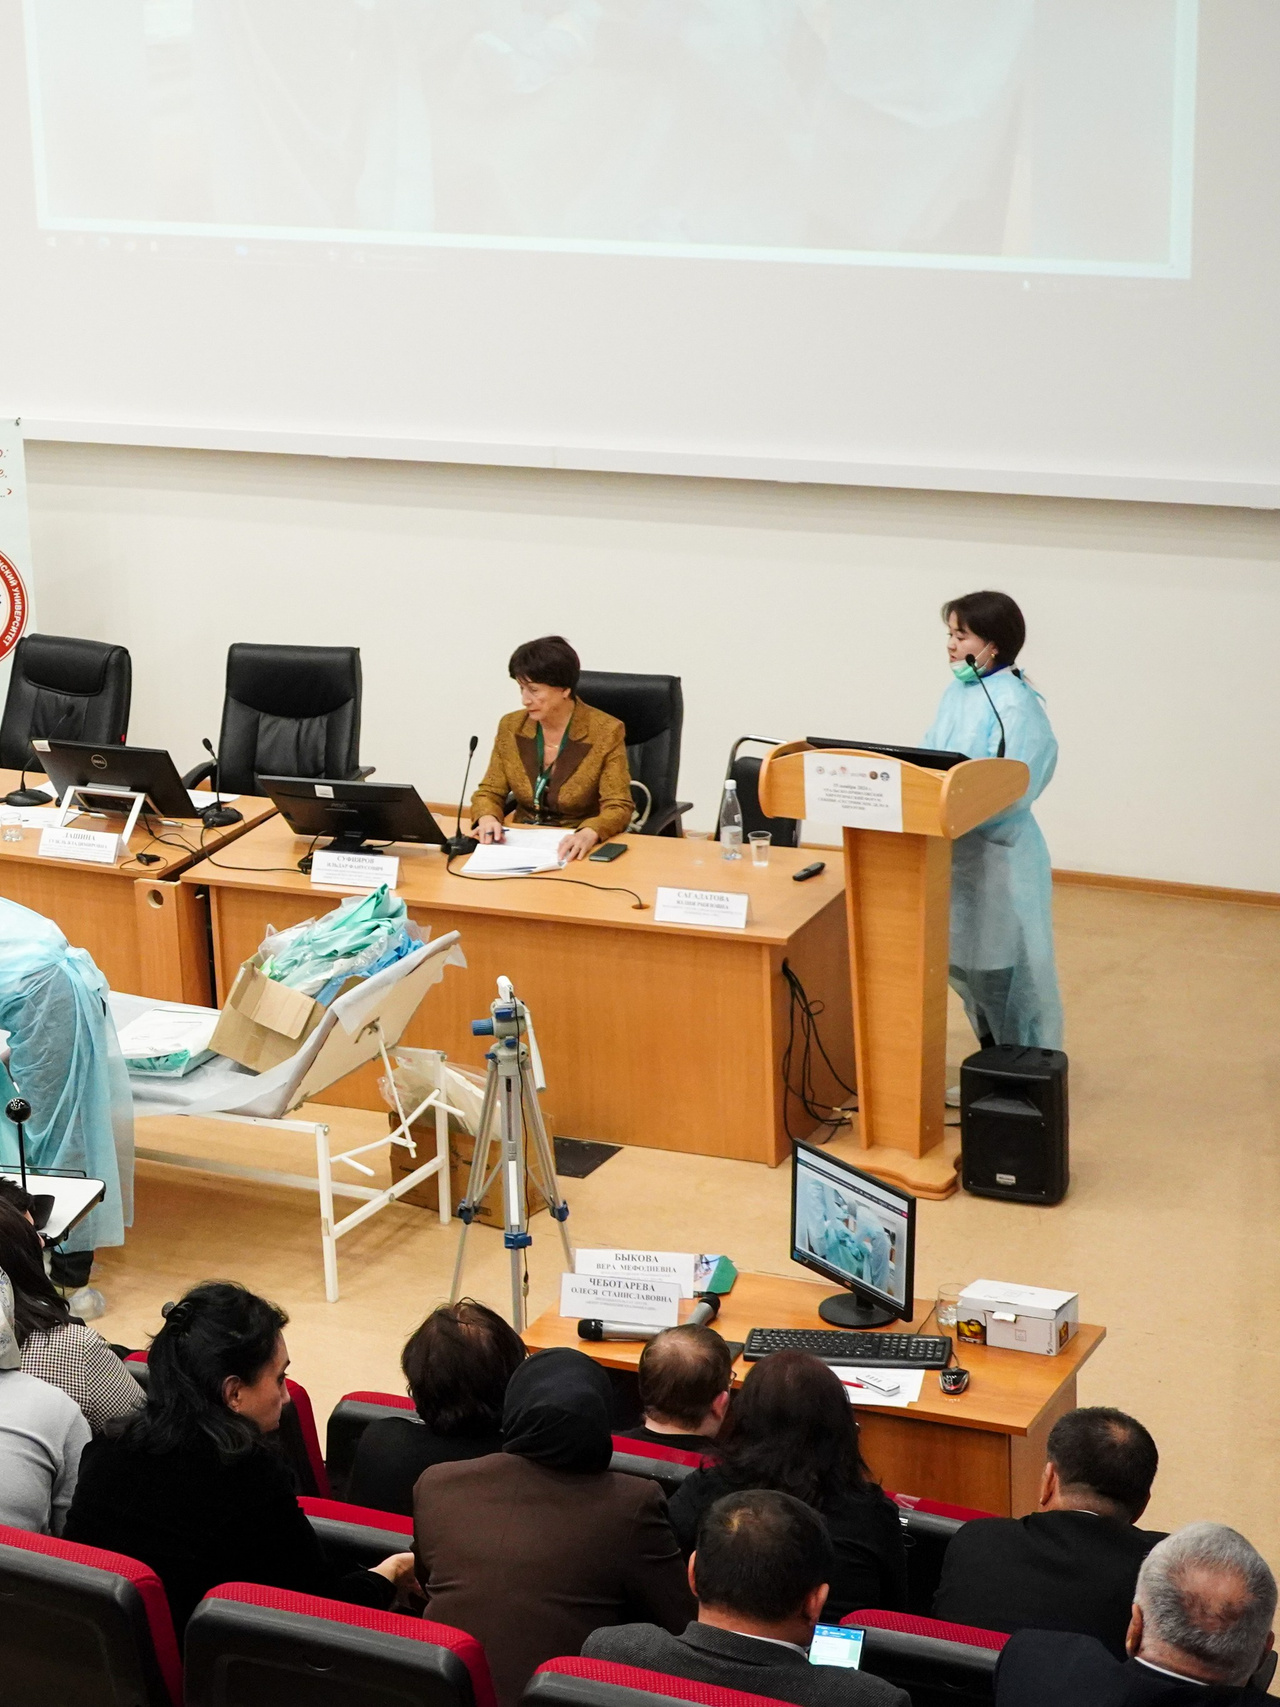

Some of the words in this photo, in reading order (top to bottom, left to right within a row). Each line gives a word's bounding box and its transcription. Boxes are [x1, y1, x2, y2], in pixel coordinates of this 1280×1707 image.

[2, 583, 22, 647] УНИВЕРСИТЕТ
[614, 1253, 659, 1263] БЫКОВА
[620, 1264, 677, 1273] МЕФОДИЕВНА
[589, 1278, 656, 1292] ЧЕБОТАРЕВА
[570, 1287, 598, 1296] ОЛЕСЯ
[601, 1290, 673, 1303] СТАНИСЛАВОВНА
